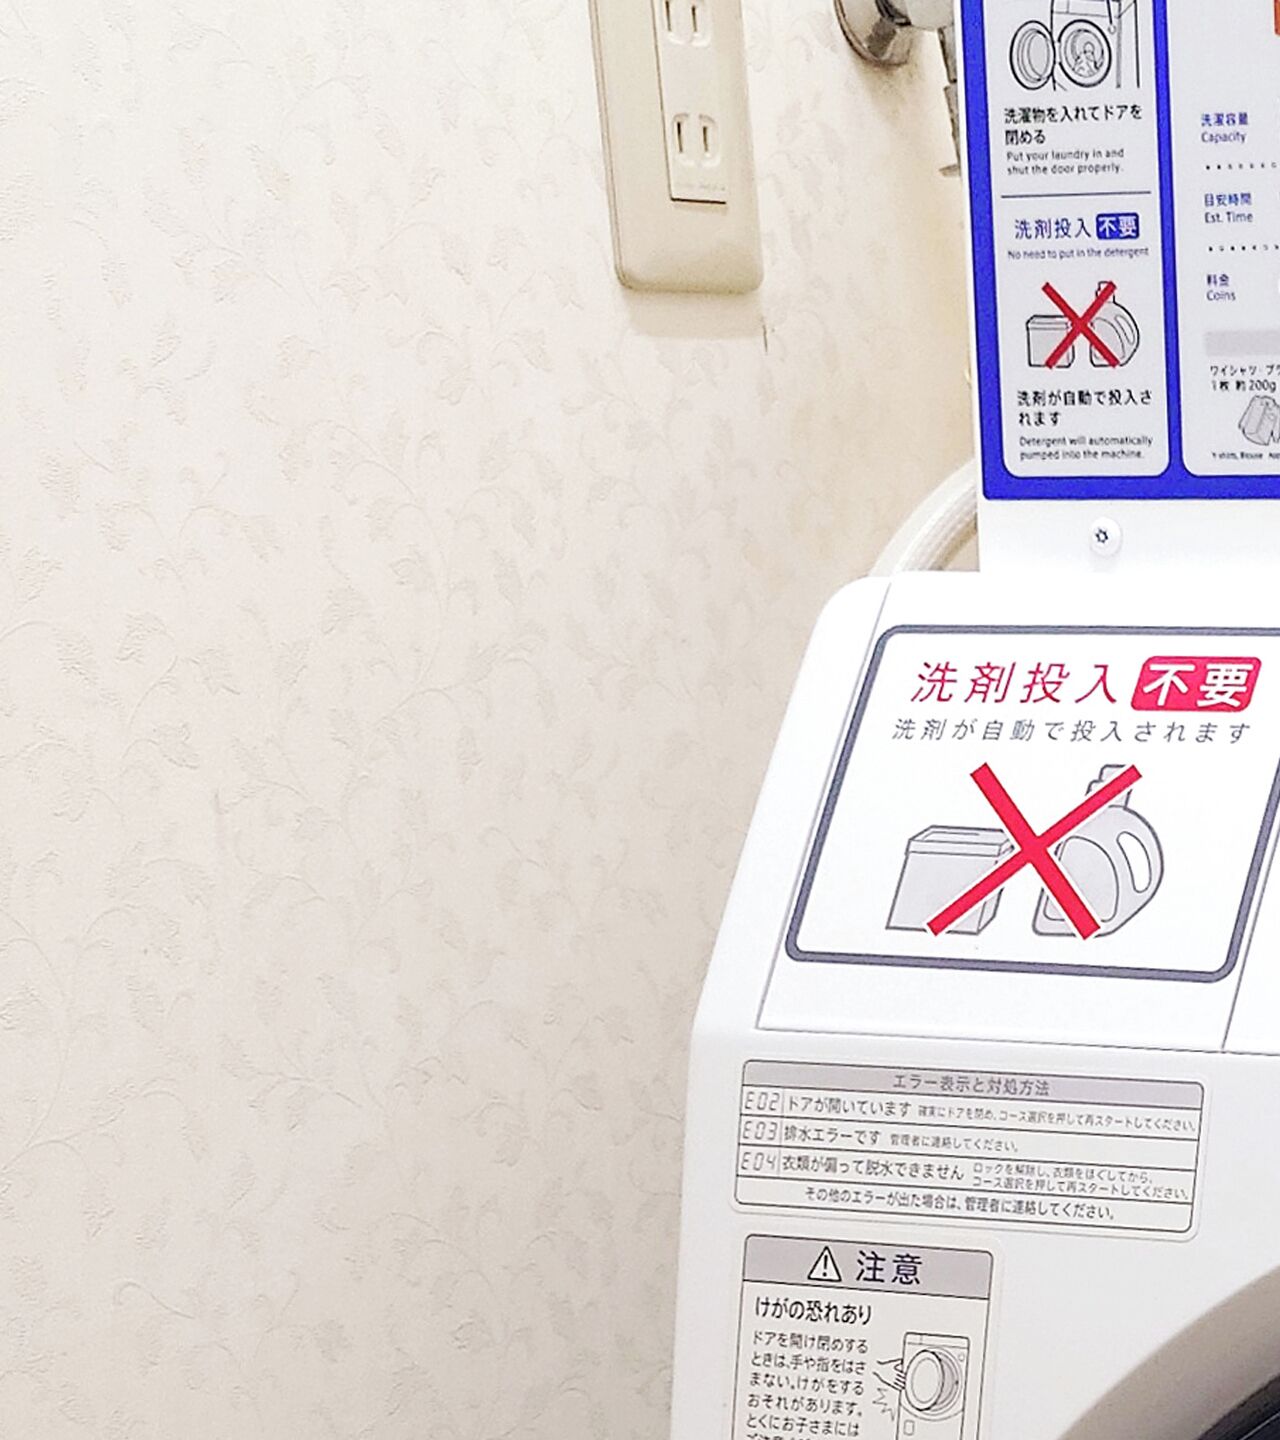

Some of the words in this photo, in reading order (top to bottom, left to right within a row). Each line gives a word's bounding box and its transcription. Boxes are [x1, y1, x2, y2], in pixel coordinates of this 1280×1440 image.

[1004, 103, 1142, 124] 洗濯物を入れてドアを
[1004, 129, 1046, 146] 閉める
[1014, 218, 1092, 240] 洗剤投入
[1097, 215, 1138, 238] 不要
[1226, 210, 1254, 223] Time
[1206, 290, 1236, 302] Coins
[910, 661, 1118, 705] 洗剤投入
[1143, 662, 1254, 708] 不要
[891, 717, 1251, 744] 洗剤が自動で投入されます
[892, 1074, 1050, 1097] エラー表示と対処方法
[788, 1096, 912, 1117] ドアが開いています
[855, 1251, 923, 1286] 注意
[754, 1296, 873, 1326] けがの恐れあり
[753, 1332, 869, 1355] ドアを開け閉めする
